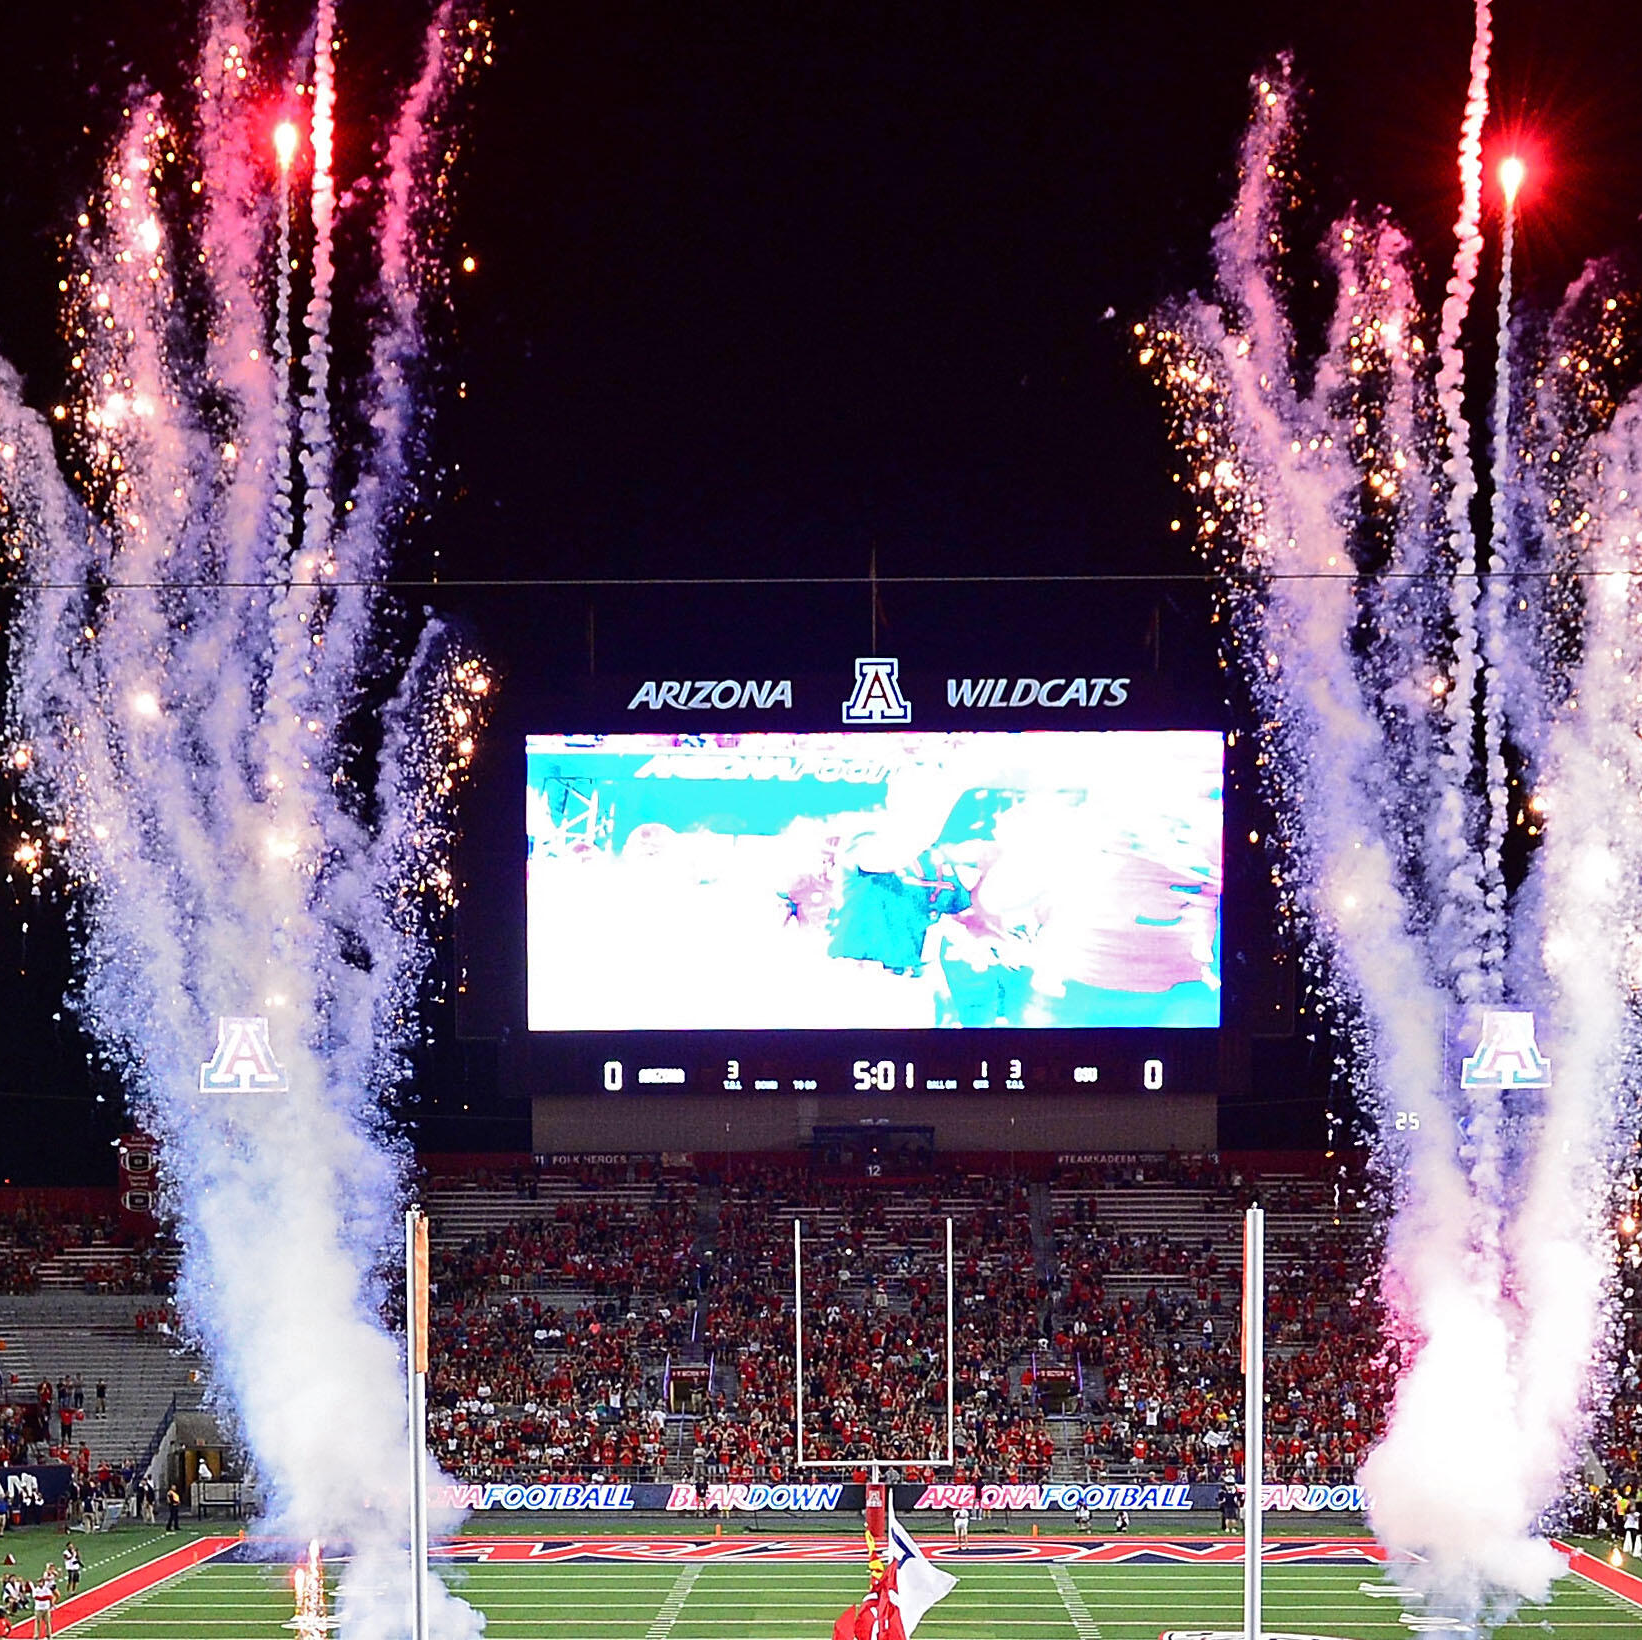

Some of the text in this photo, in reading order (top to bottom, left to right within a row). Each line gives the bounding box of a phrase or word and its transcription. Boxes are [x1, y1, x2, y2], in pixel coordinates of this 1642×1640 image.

[628, 680, 793, 711] ARIZONA
[842, 658, 911, 723] A
[947, 678, 1131, 707] WILDCATS
[199, 1016, 288, 1092] A
[604, 1061, 623, 1091] 0
[727, 1060, 740, 1079] 3
[1010, 1060, 1022, 1078] 3
[1144, 1060, 1163, 1090] 0
[1395, 1112, 1420, 1131] 25
[868, 1165, 880, 1177] 12
[429, 1483, 635, 1511] ONAFOOTBALL
